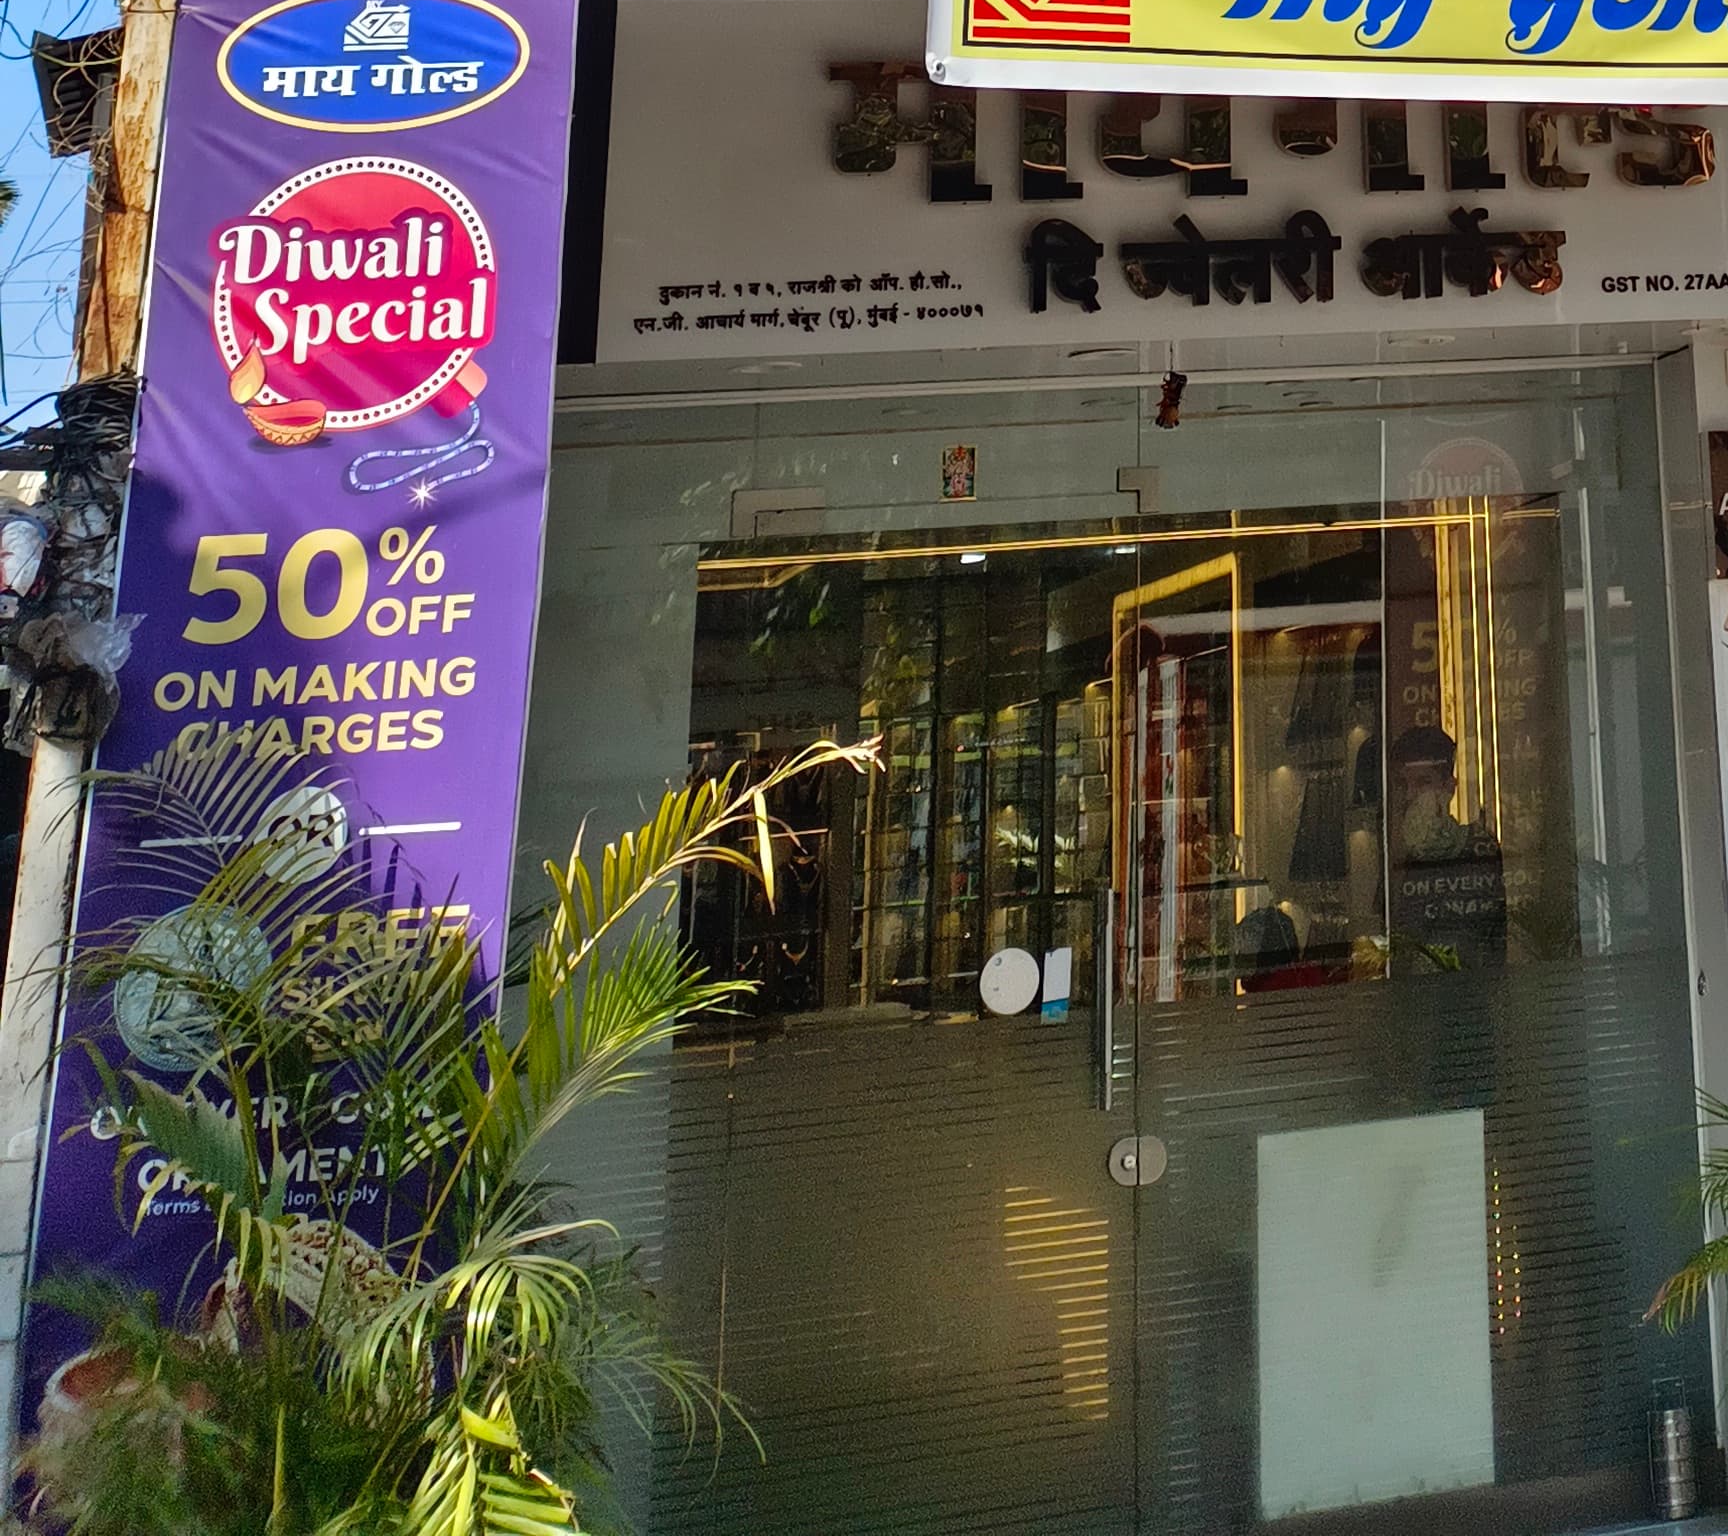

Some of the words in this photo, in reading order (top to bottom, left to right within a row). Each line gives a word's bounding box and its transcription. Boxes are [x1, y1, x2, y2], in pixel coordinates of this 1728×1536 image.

[262, 61, 357, 101] माय
[371, 54, 485, 99] गोल्ड
[218, 216, 446, 287] Diwali
[1025, 219, 1104, 315] दि
[1601, 276, 1640, 294] GST
[1646, 274, 1679, 293] NO.
[254, 277, 489, 366] Special
[364, 593, 476, 639] OFF
[153, 671, 237, 712] ON
[252, 656, 477, 708] MAKING
[176, 709, 447, 762] CHARGES
